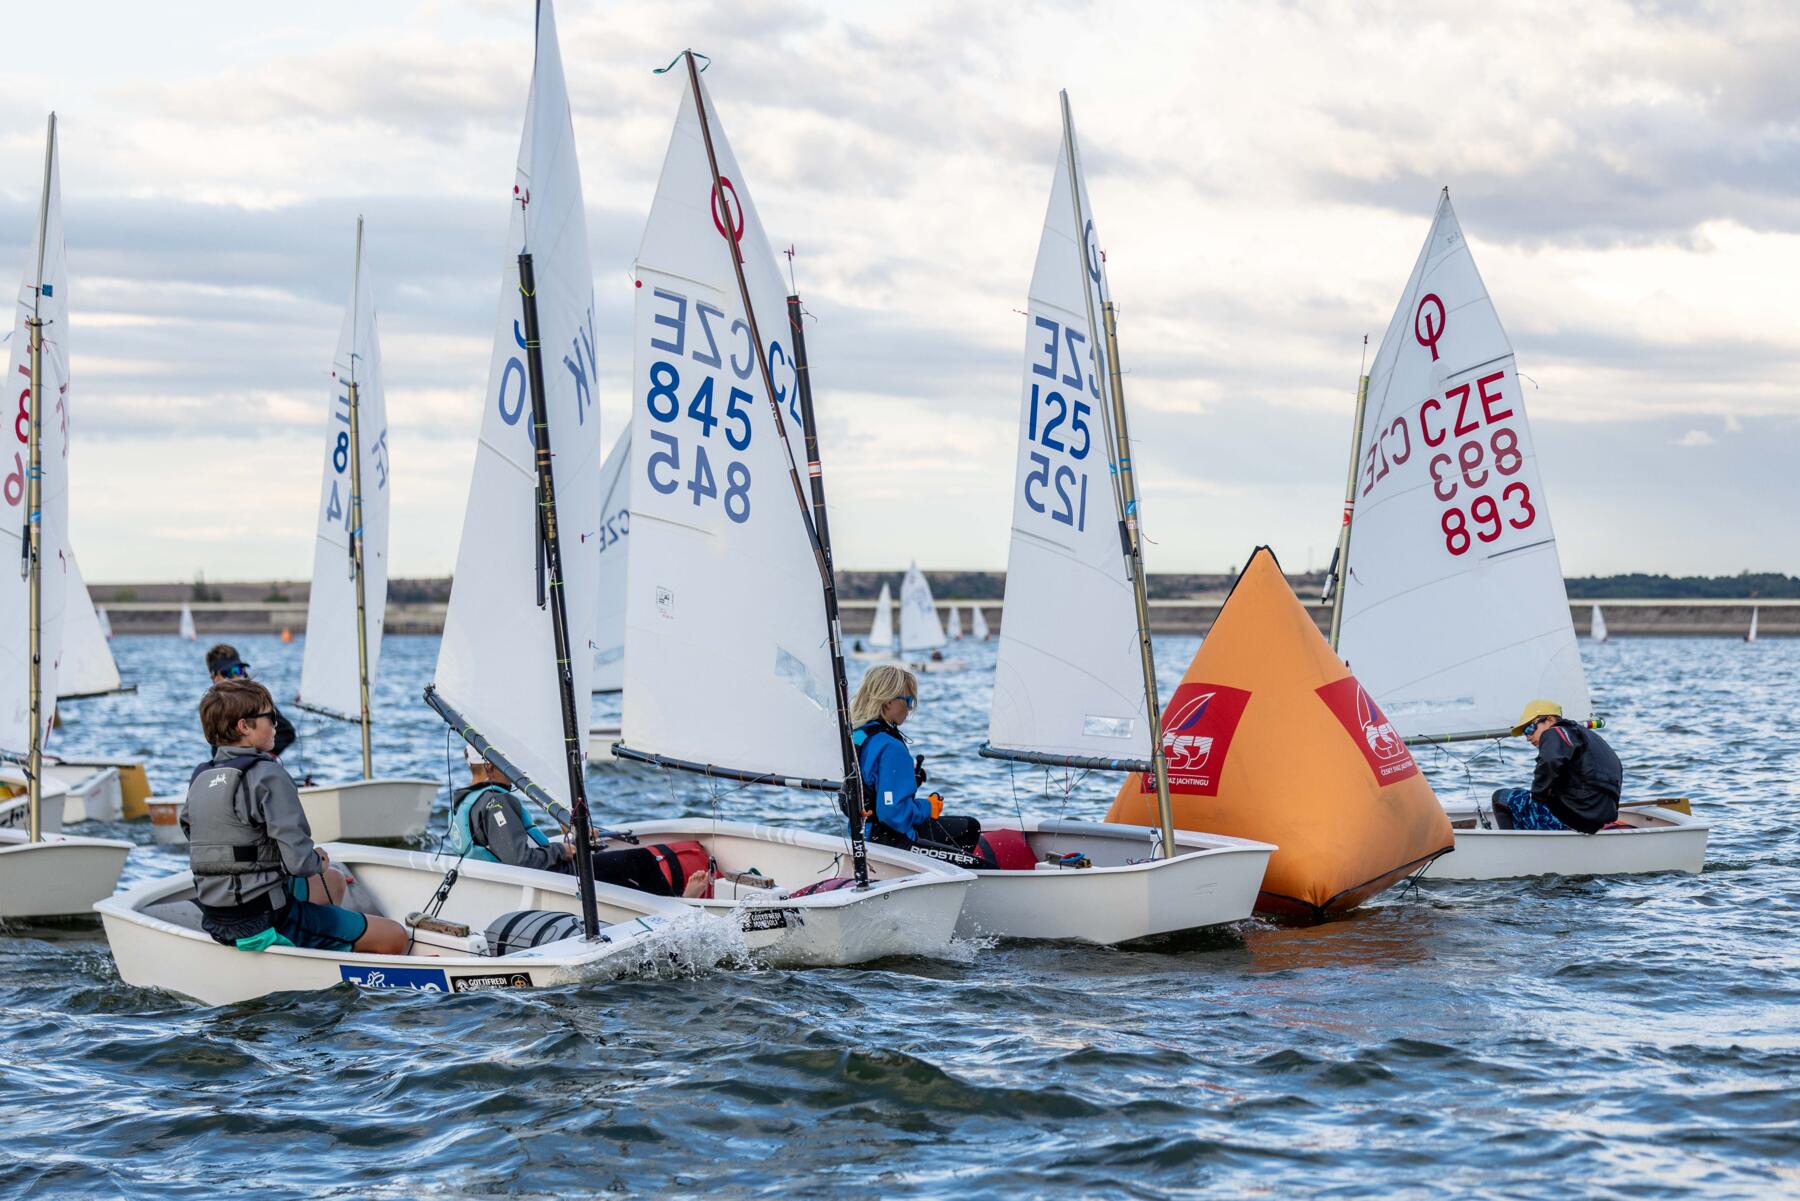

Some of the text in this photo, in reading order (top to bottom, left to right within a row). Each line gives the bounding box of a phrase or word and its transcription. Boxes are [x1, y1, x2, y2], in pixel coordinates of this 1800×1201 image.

[645, 360, 754, 452] 845
[1027, 383, 1092, 461] 125
[1420, 370, 1514, 448] CZE
[1441, 482, 1536, 556] 893
[1176, 778, 1209, 787] JACHTINGU
[910, 846, 974, 864] ROOSTER
[468, 977, 508, 987] GOTTIFREDI
